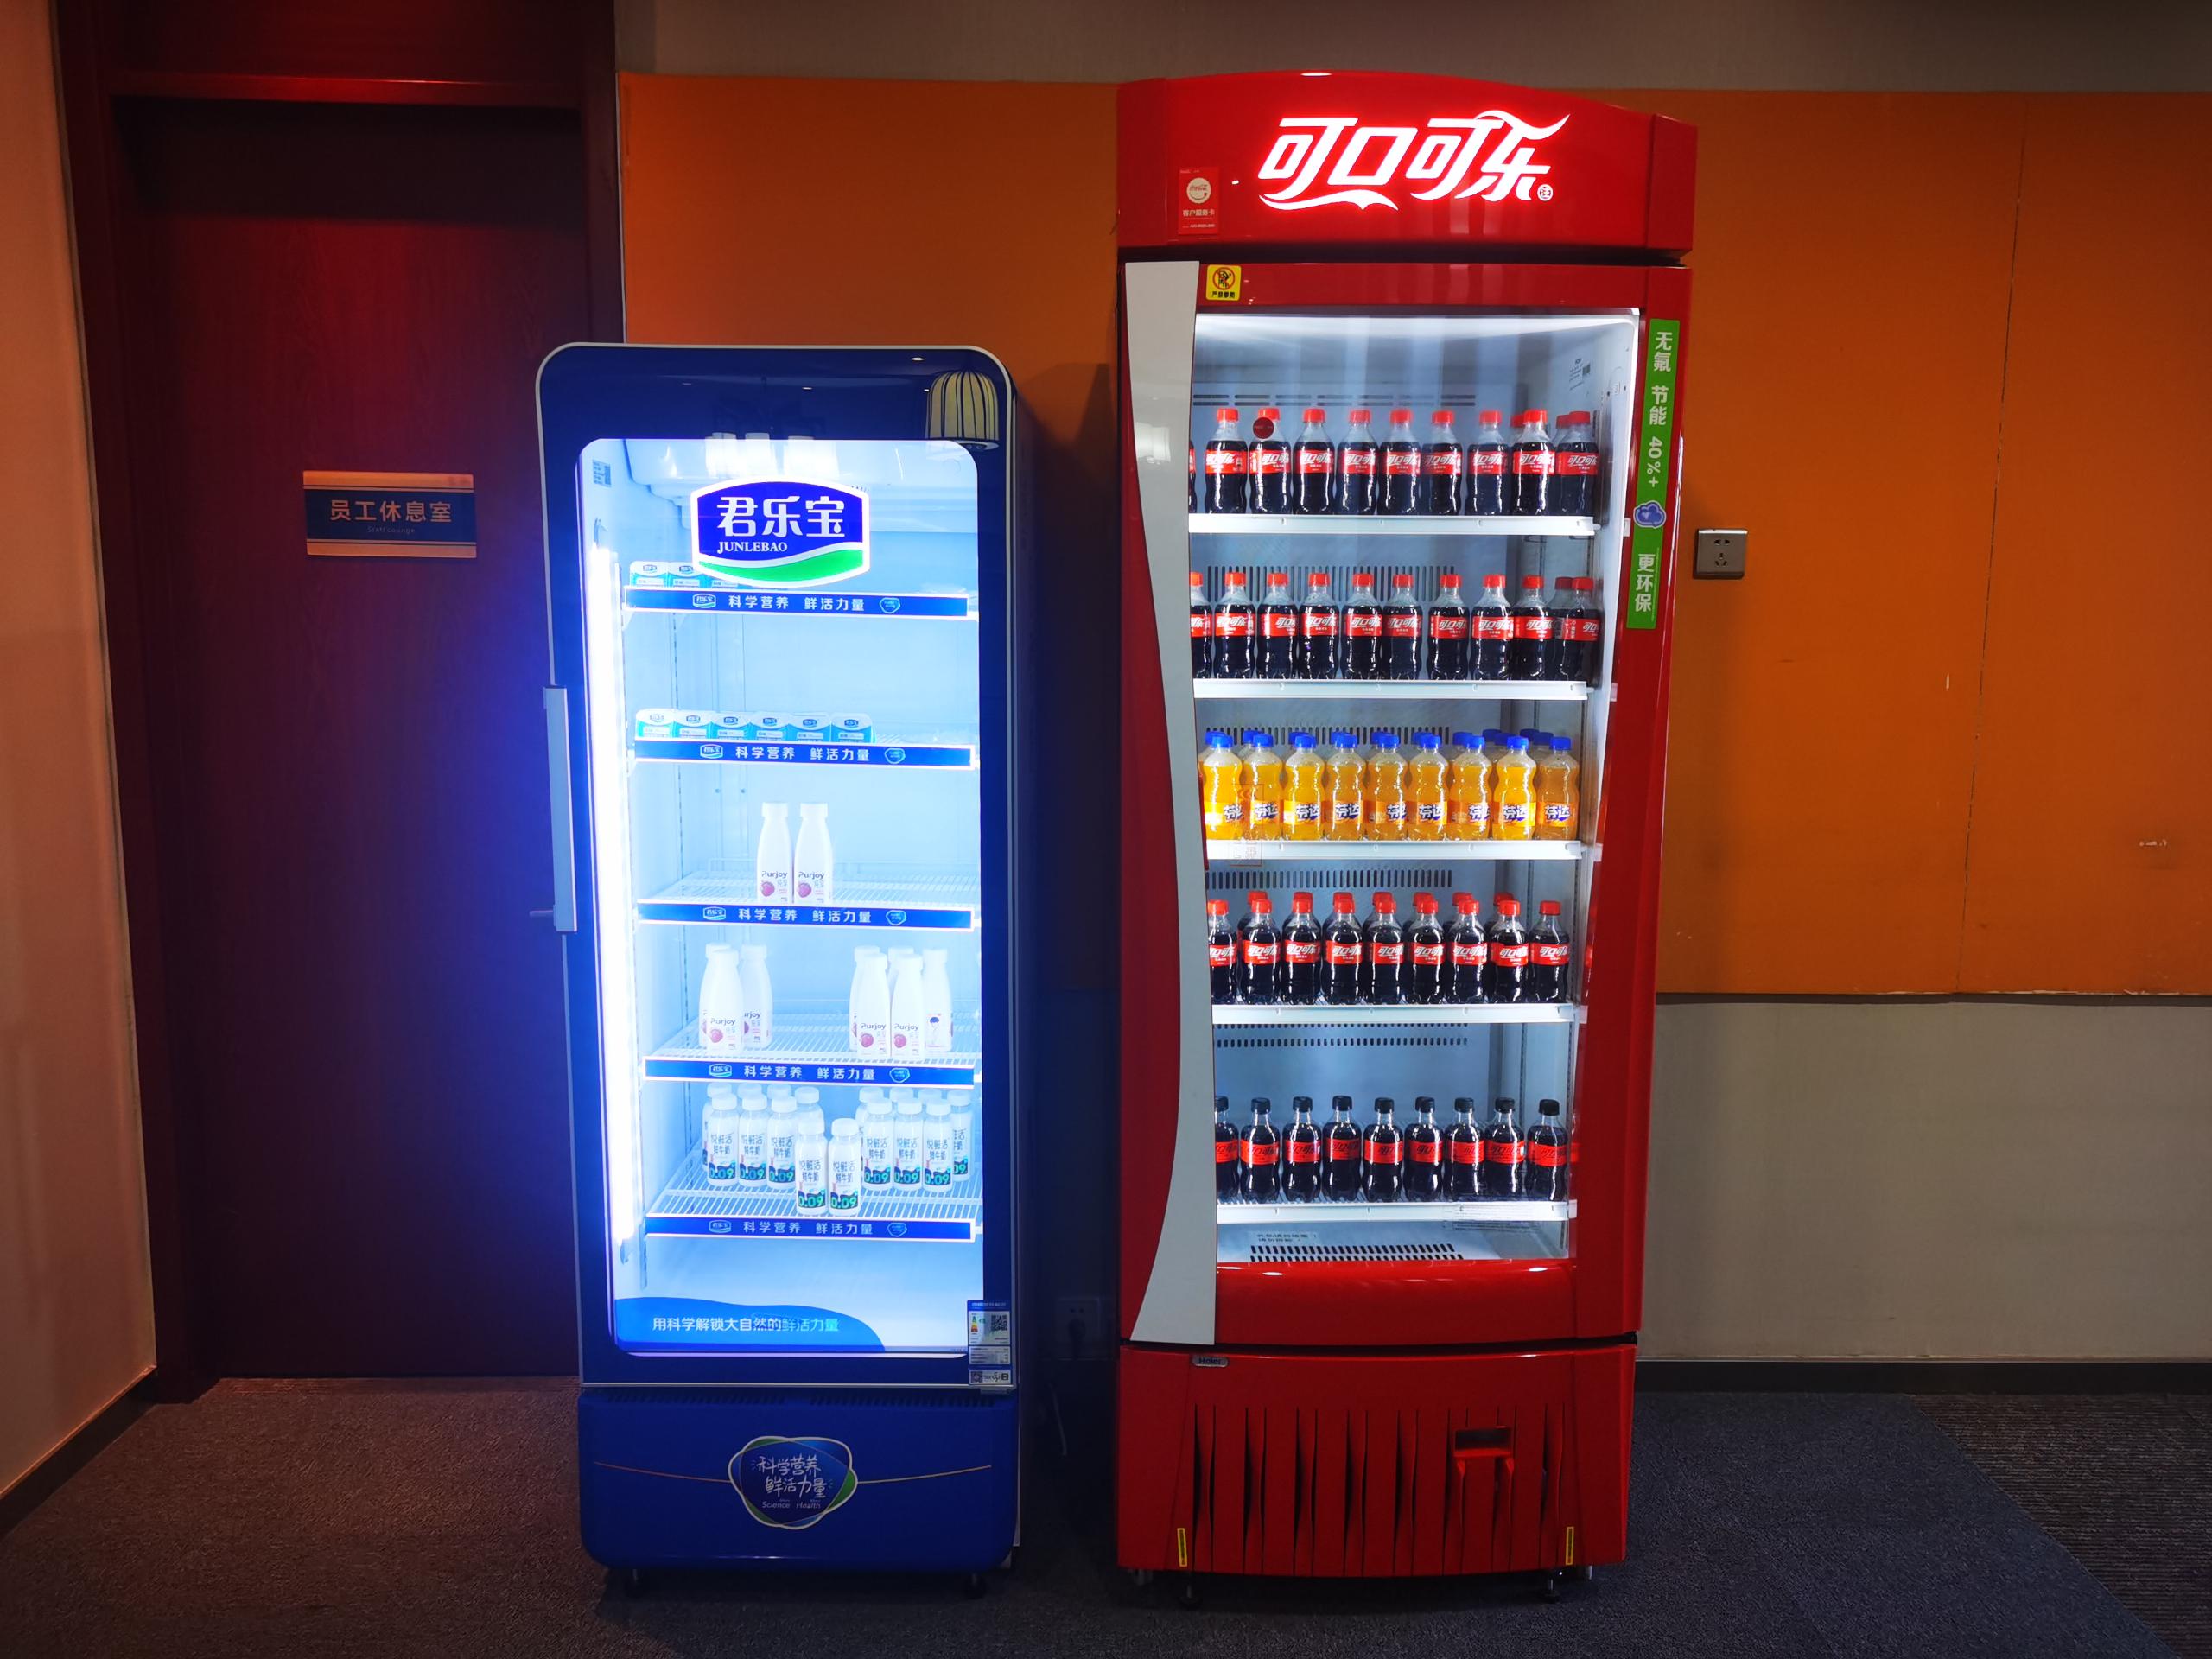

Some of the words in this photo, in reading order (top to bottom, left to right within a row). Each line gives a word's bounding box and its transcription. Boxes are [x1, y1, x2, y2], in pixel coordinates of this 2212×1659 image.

[1258, 110, 1570, 210] 可口可乐
[1654, 331, 1673, 372] 无氟
[1649, 385, 1669, 426] 节能
[1646, 436, 1663, 488] 40%+
[330, 499, 452, 523] 员工休息室
[717, 496, 845, 538] 君乐宝
[717, 541, 787, 554] JUNLEBAO
[1635, 553, 1656, 613] 更环保
[728, 594, 789, 609] 科学营养
[804, 597, 864, 612] 鲜活力量
[735, 746, 795, 760] 科学营养
[810, 748, 869, 761] 鲜活力量
[761, 870, 788, 879] Purjoy
[798, 871, 824, 880] Purjoy
[738, 908, 798, 922] 科学营养
[812, 909, 872, 924] 鲜活力量
[744, 1065, 802, 1078] 科学营养
[817, 1067, 874, 1080] 鲜活力量
[743, 1221, 802, 1234] 科学营养
[816, 1223, 873, 1236] 鲜活力量
[652, 1317, 840, 1332] 用科学解锁大自然的鲜活力量
[756, 1453, 822, 1478] 科学营养
[766, 1475, 827, 1499] 鲜活力量
[761, 1500, 791, 1510] Science
[796, 1501, 821, 1510] Health
